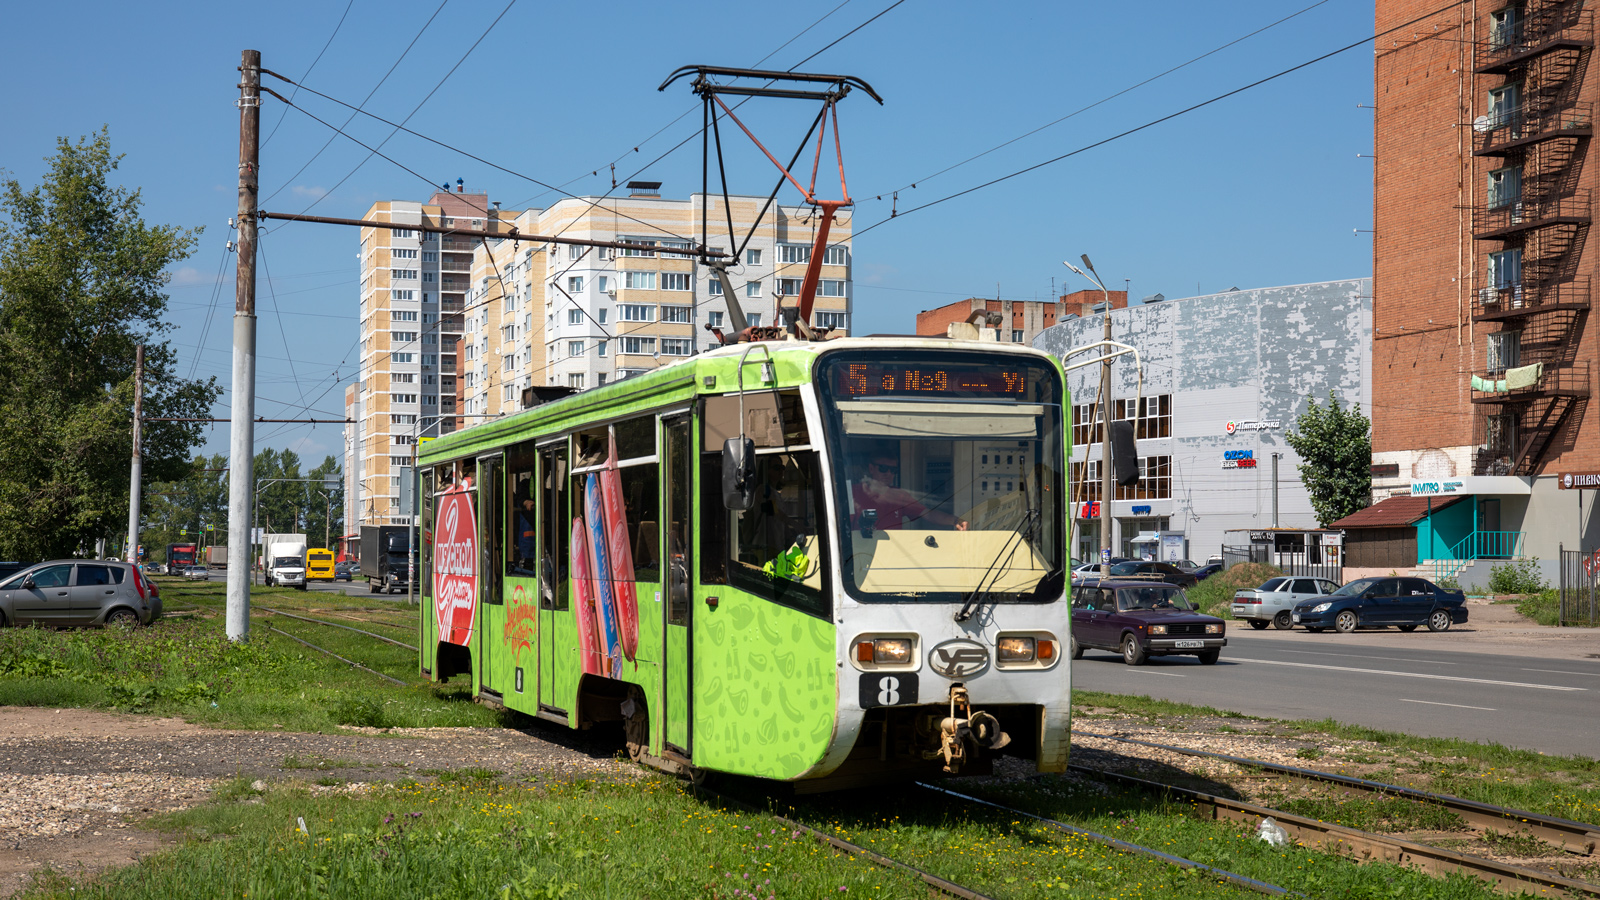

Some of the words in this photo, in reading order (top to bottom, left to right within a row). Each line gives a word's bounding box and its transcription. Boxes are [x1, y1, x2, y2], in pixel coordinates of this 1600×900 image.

[850, 364, 867, 394] 5
[1224, 450, 1253, 460] OZON
[1412, 482, 1440, 493] INVITRO
[437, 538, 473, 577] МЯСНОЙ
[878, 676, 900, 705] 8
